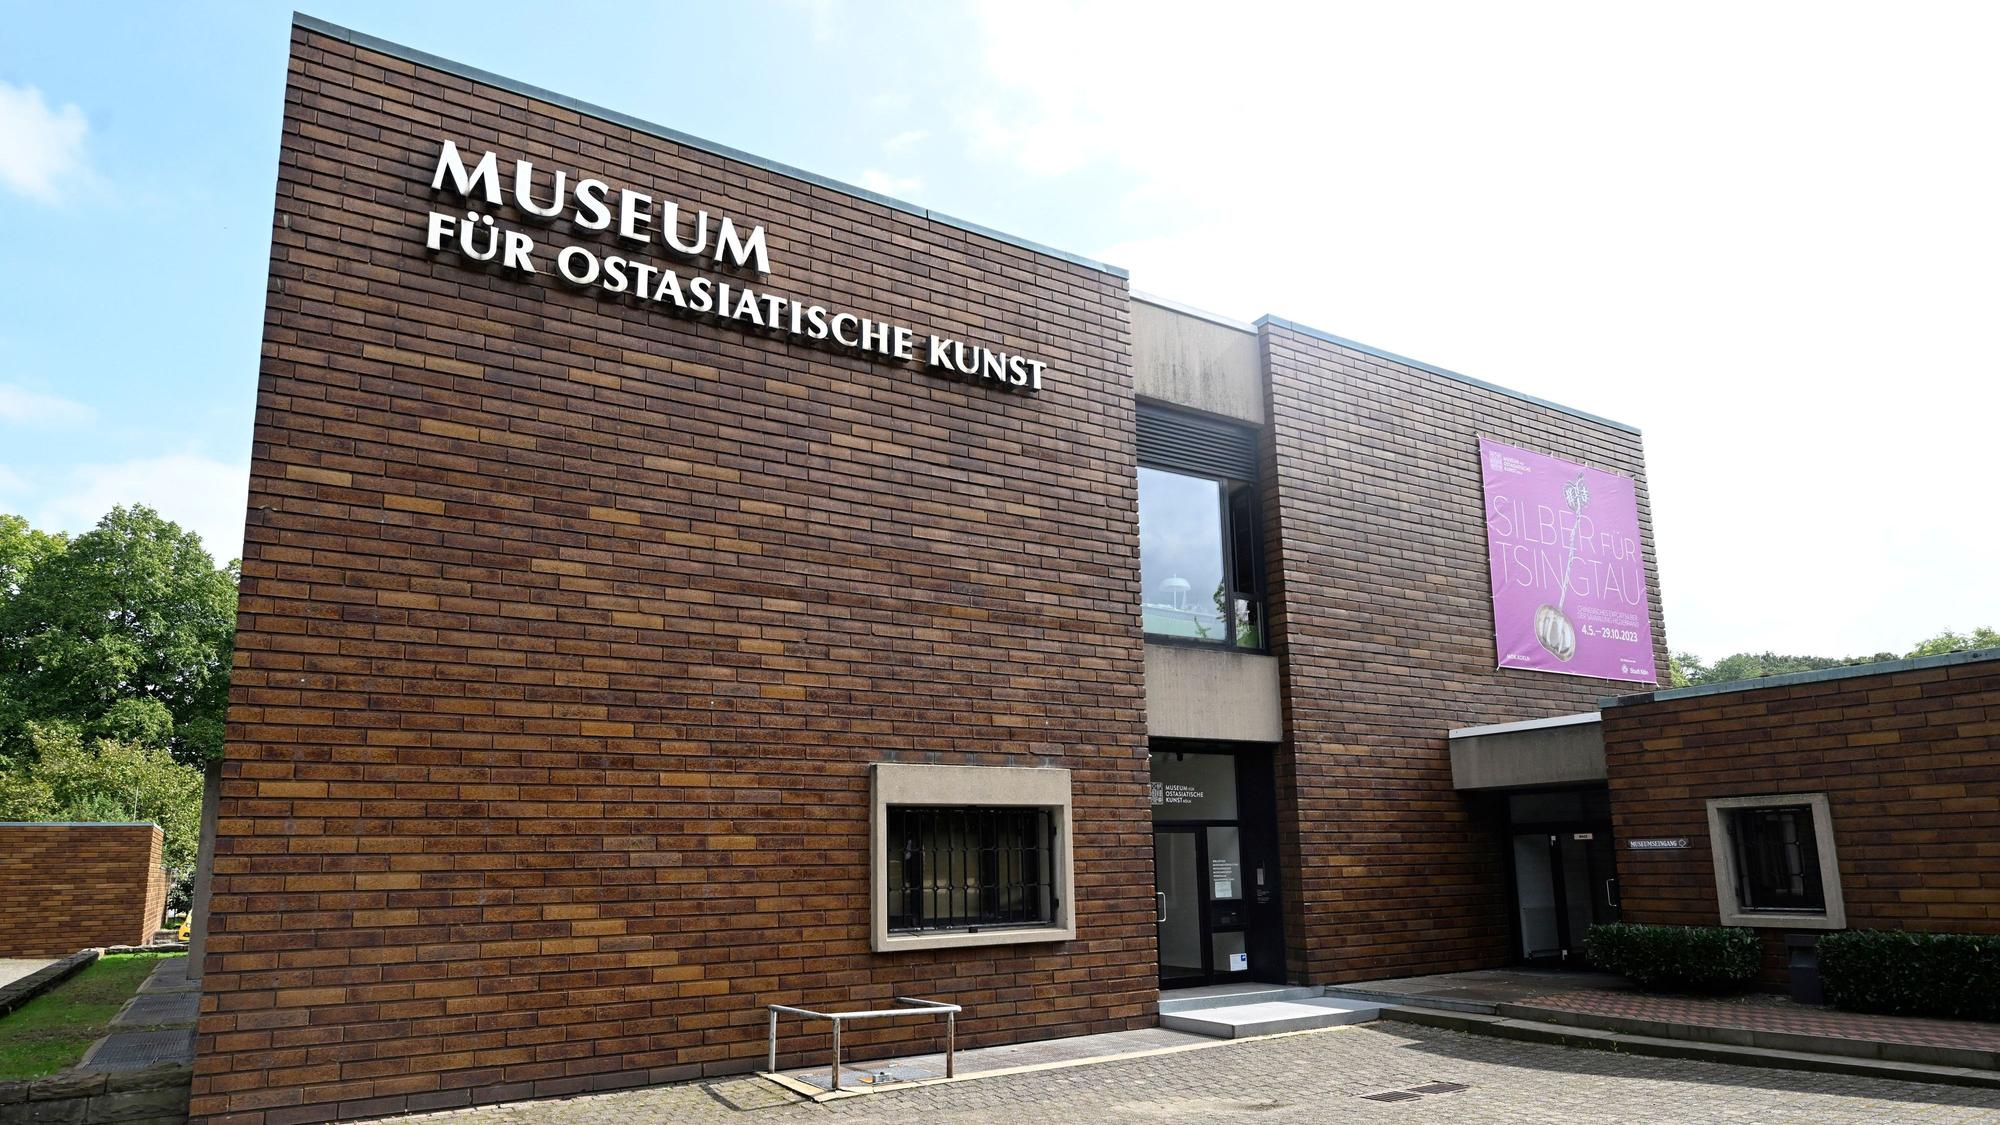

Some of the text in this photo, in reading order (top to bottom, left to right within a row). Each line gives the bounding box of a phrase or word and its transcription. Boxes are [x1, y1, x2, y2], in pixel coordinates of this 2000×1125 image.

[431, 139, 771, 276] MUSEUM
[426, 211, 1047, 392] FÜR OSTASIATISCHE KUNST
[1492, 495, 1636, 562] SILBER FÜR
[1495, 541, 1641, 606] TSINGTAU
